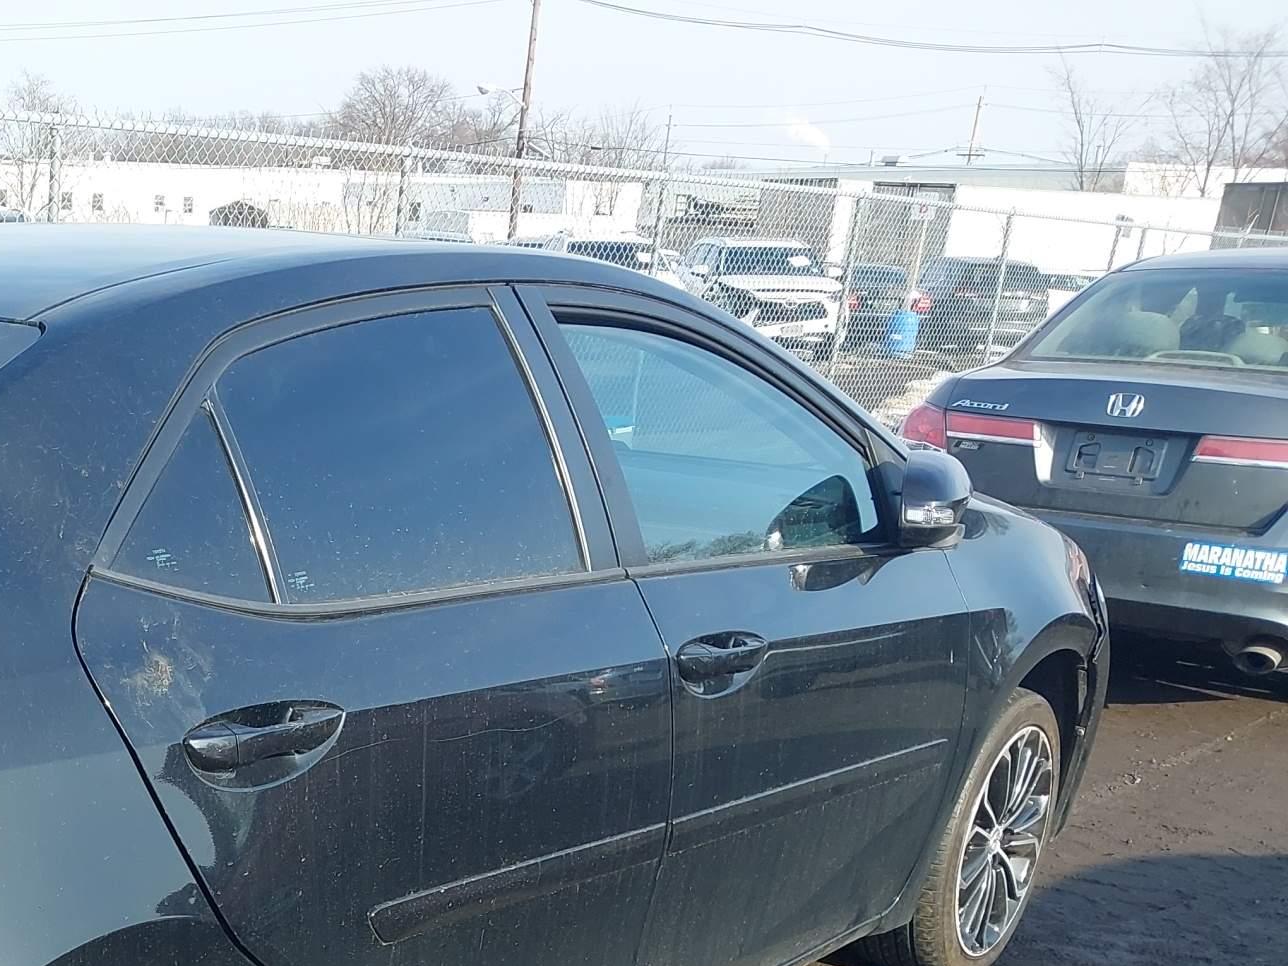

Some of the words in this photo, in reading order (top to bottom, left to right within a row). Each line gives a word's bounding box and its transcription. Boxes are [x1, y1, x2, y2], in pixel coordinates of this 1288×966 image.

[952, 399, 1009, 411] Accord
[1182, 542, 1288, 572] MARANATHA
[1180, 560, 1217, 574] Jesus
